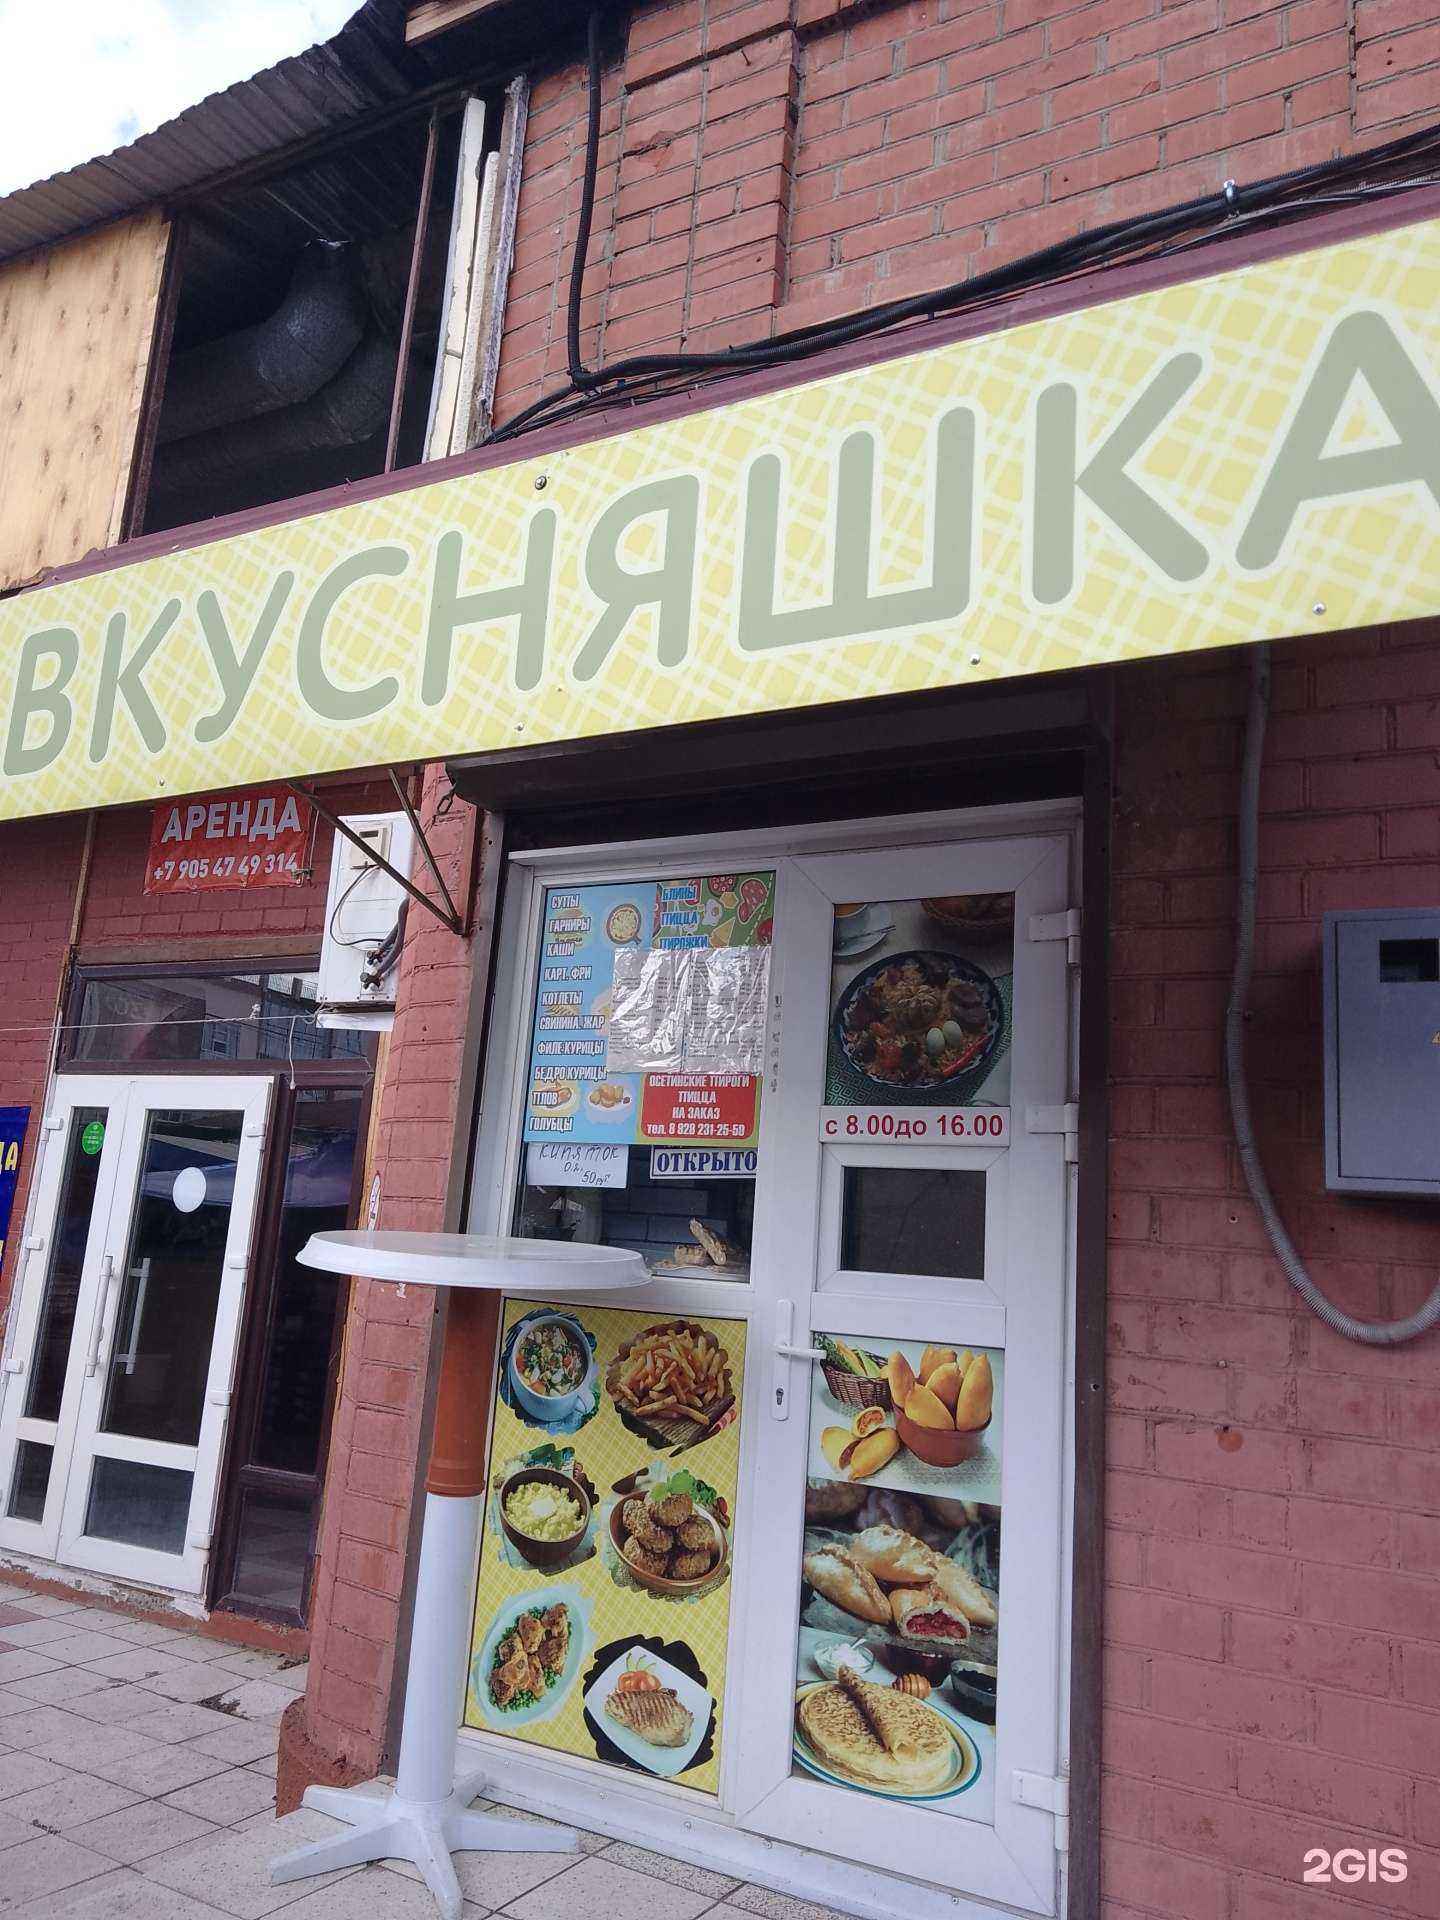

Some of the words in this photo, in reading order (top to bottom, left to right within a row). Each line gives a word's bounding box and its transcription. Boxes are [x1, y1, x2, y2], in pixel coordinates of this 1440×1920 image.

[3, 309, 1440, 776] ВКУСНЯШКА
[161, 796, 301, 843] АРЕНДА
[154, 861, 176, 880] +7
[178, 858, 209, 879] 905
[212, 855, 234, 877] 47
[238, 853, 260, 876] 49
[264, 852, 297, 874] 314
[551, 894, 580, 909] СУПЫ
[549, 917, 591, 933] ГАРНИРЫ
[661, 911, 699, 926] ПИЦЦА
[546, 942, 575, 957] КАШИ
[660, 935, 708, 949] ПИРОЖКИ
[571, 965, 592, 980] ФРИ
[541, 991, 583, 1005] КОТЛЕТЫ
[649, 1075, 708, 1087] ОСЕТИНСКИЕ
[710, 1076, 750, 1087] ПИРОГИ
[532, 1091, 558, 1105] ПЛОВ
[678, 1091, 716, 1104] ПИЦЦА
[672, 1107, 686, 1119] НА
[687, 1107, 721, 1119] ЗАКАЗ
[529, 1117, 573, 1133] ГОЛУБЦЫ
[825, 1119, 838, 1135] с
[937, 1114, 1003, 1136] 16.00
[656, 1151, 757, 1172] ОТКРЫТО
